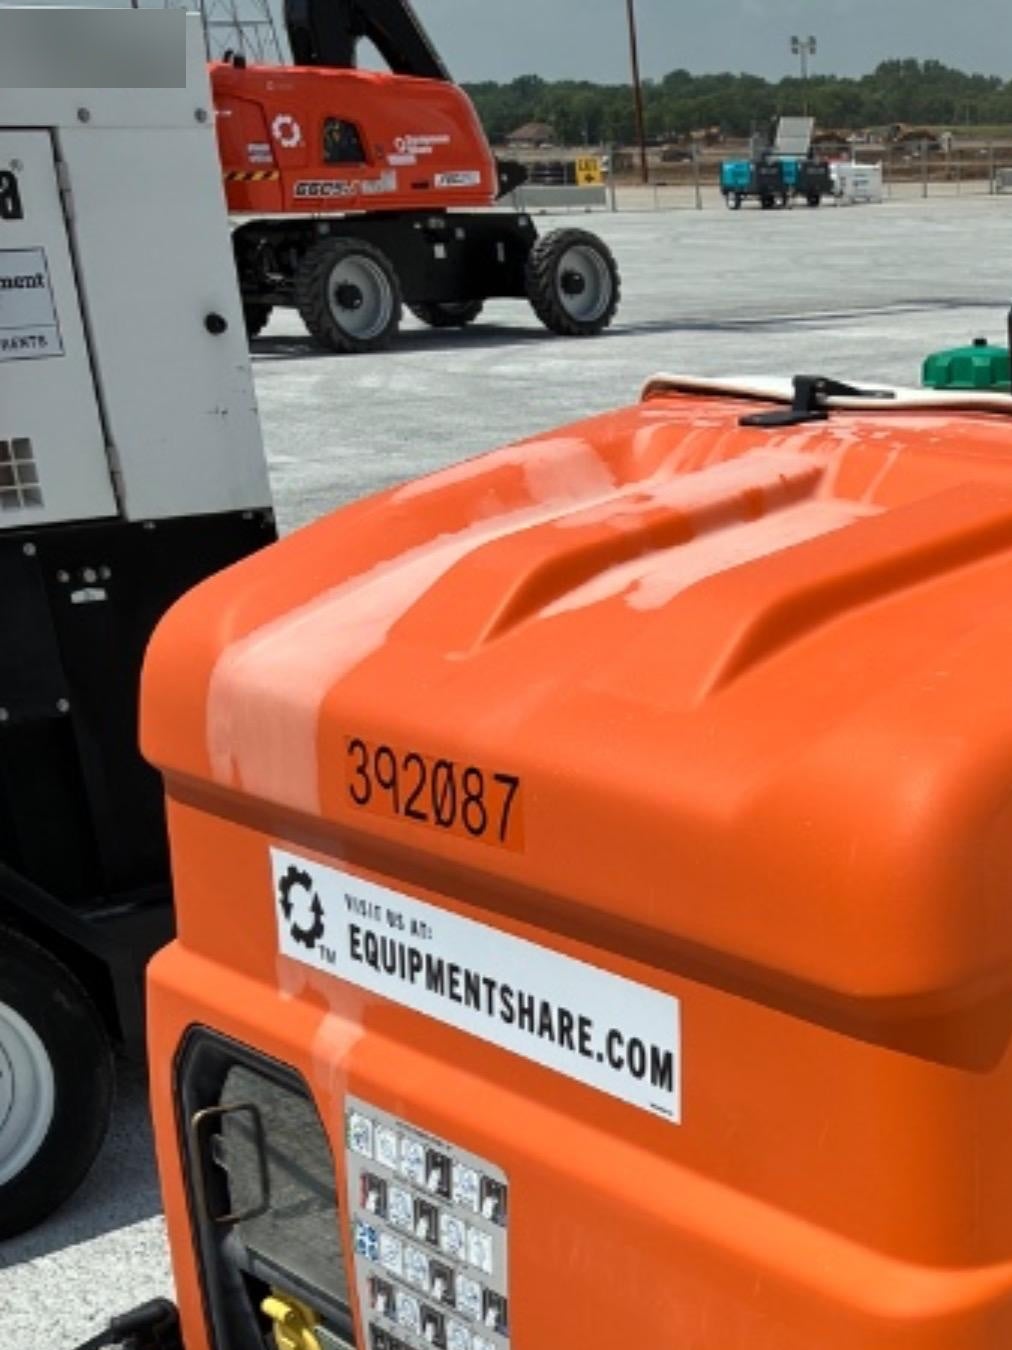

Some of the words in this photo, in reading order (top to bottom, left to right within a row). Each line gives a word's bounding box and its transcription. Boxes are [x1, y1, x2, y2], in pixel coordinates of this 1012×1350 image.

[347, 737, 520, 842] 392087
[344, 893, 382, 922] VISIT
[386, 908, 405, 931] US
[348, 923, 674, 1093] EQUIPMENTSHARE.COM
